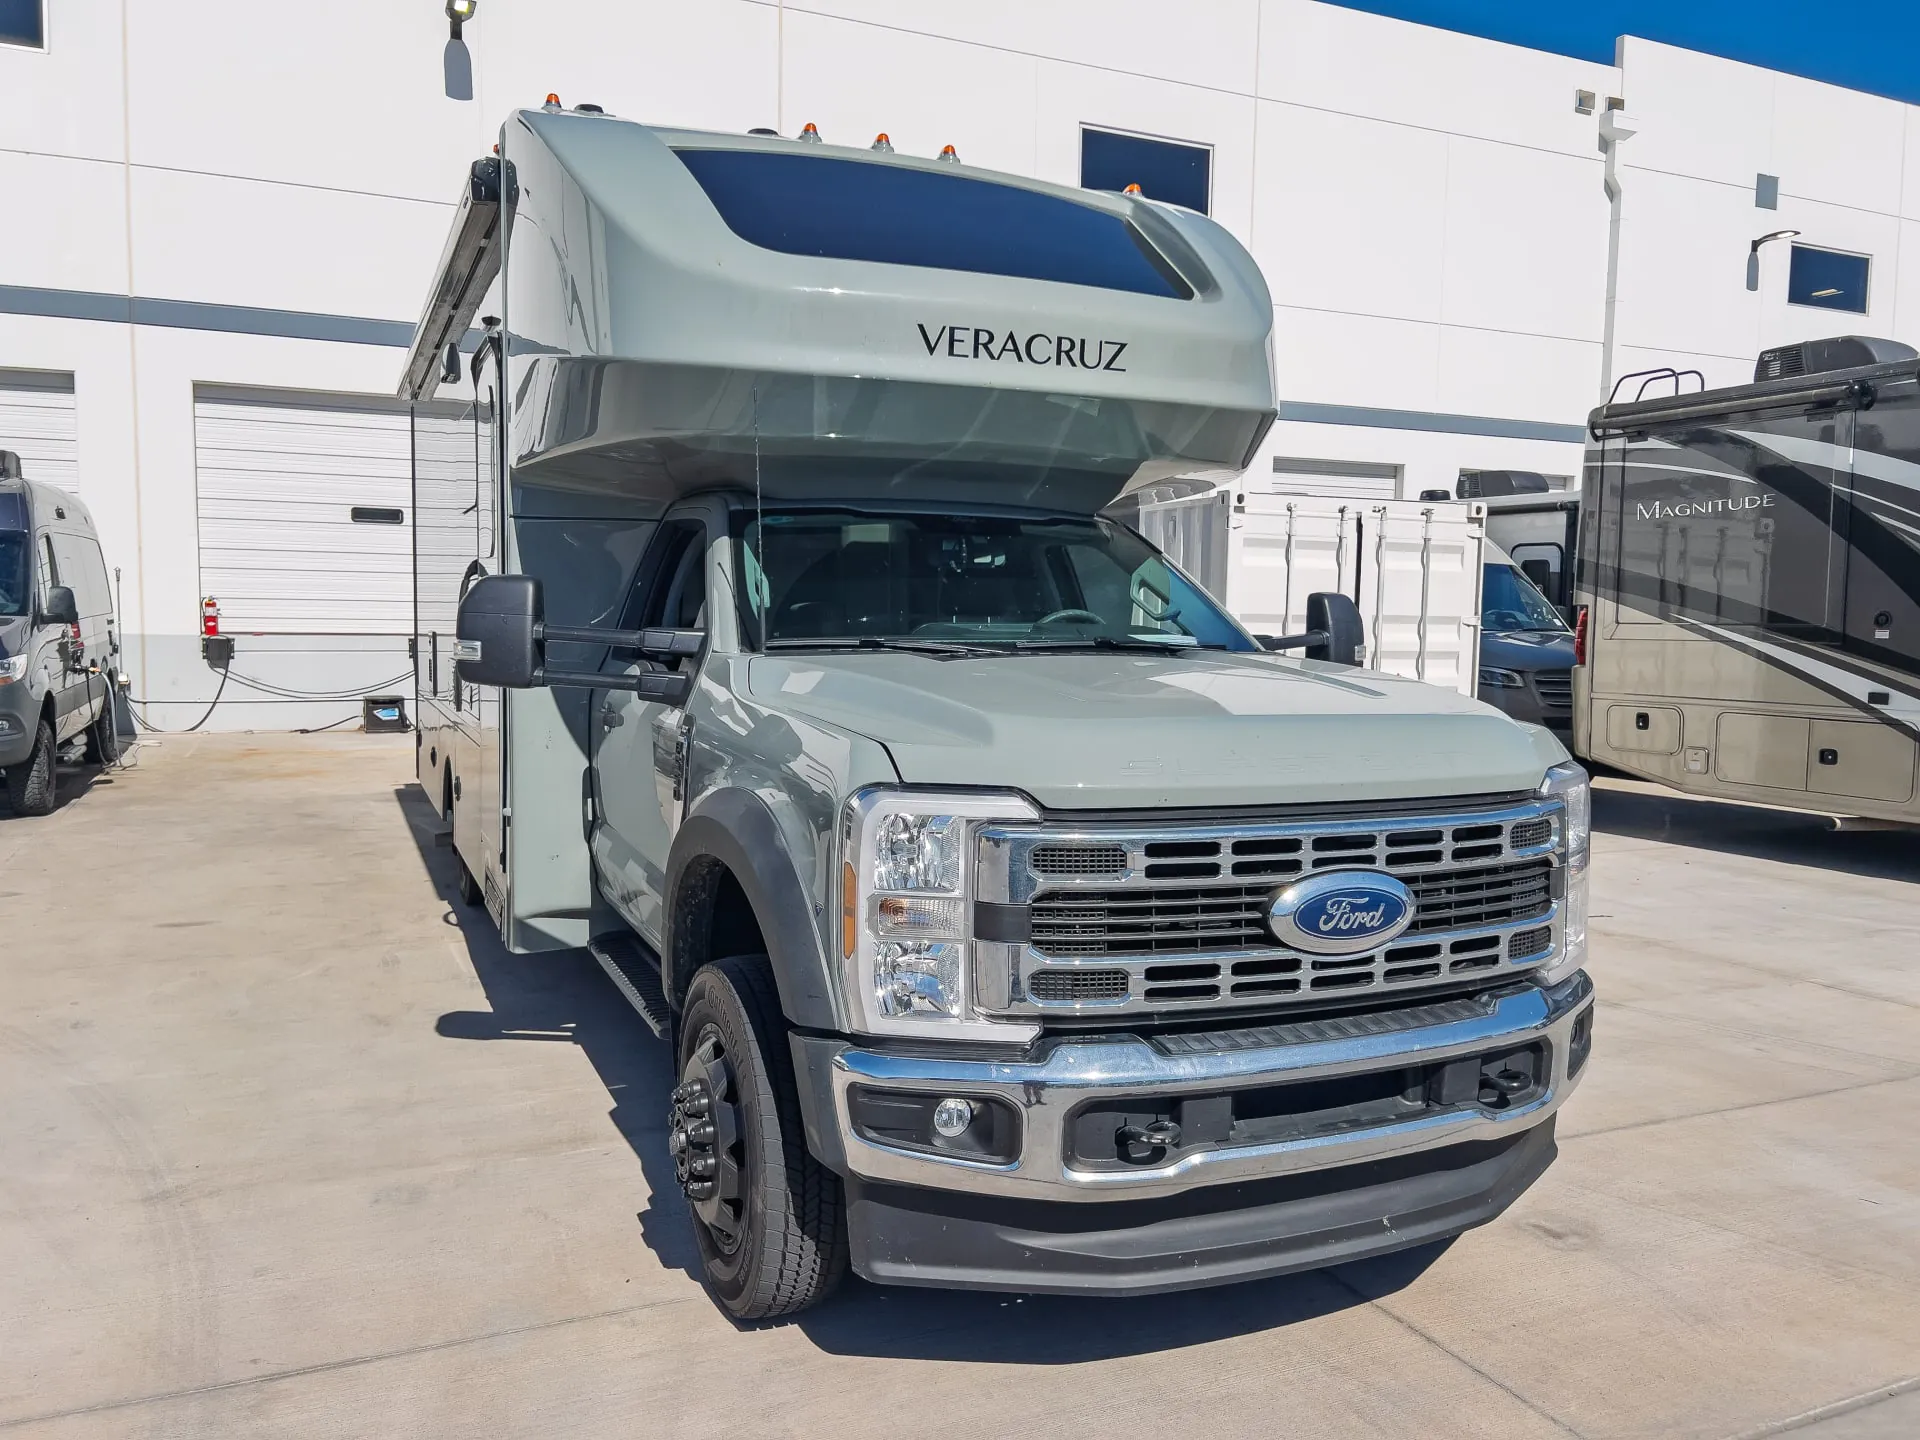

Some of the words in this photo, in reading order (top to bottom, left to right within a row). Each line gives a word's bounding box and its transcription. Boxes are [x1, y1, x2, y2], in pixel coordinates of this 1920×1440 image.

[917, 323, 1128, 372] VERACRUZ
[1637, 493, 1777, 521] MAGNITUDE
[1318, 897, 1386, 931] Ford
